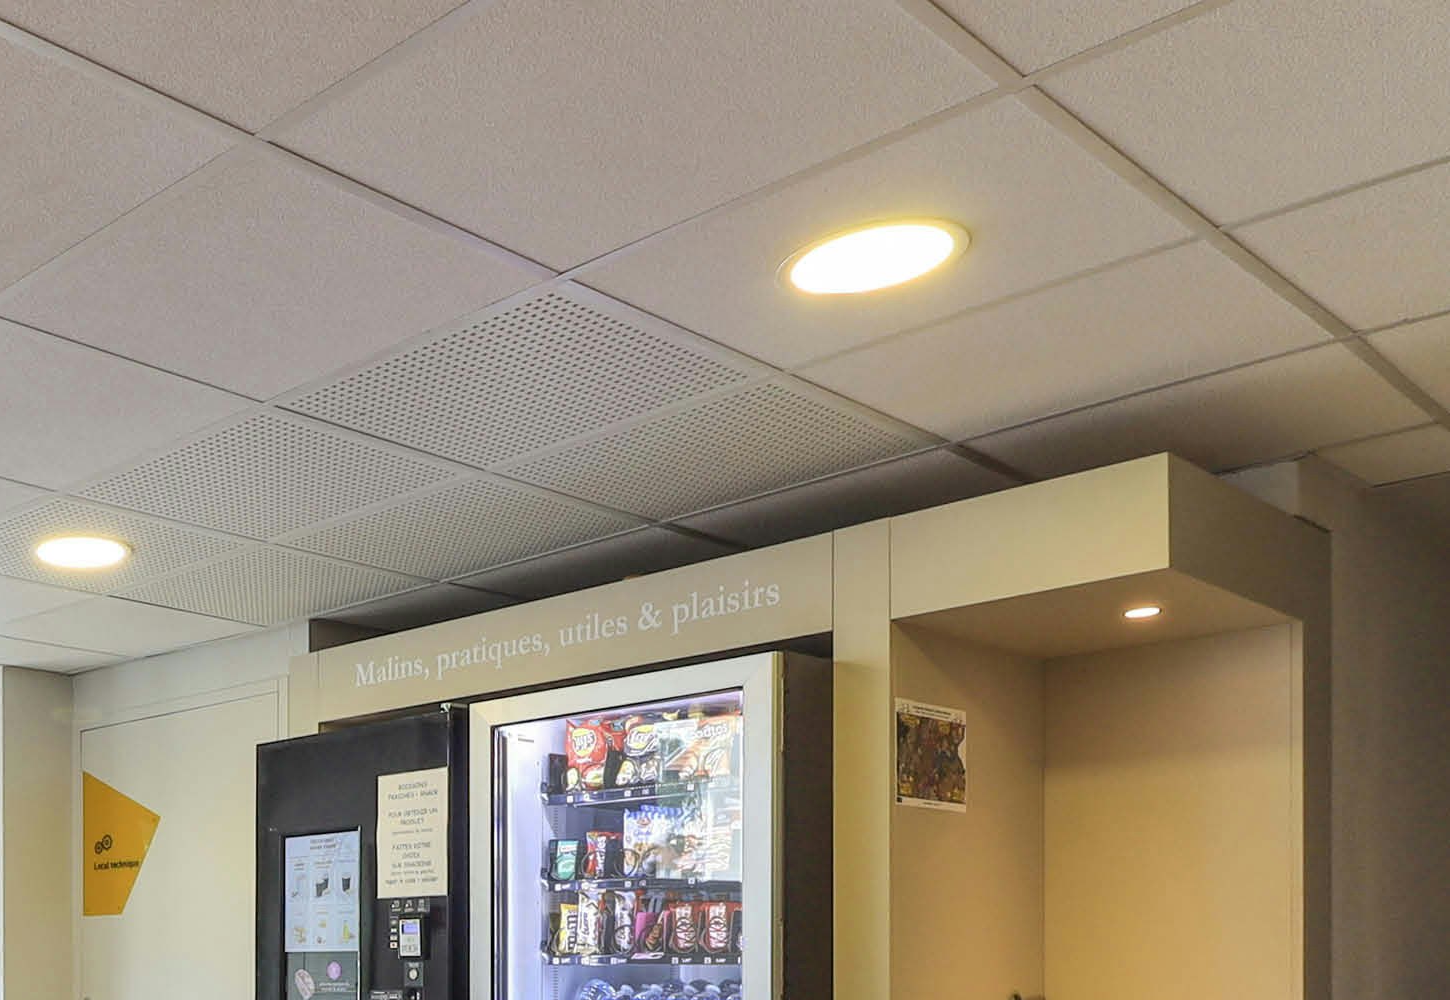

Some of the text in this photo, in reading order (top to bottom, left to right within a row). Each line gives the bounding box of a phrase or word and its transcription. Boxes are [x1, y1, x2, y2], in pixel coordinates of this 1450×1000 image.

[354, 579, 781, 688] Malins, pratiques, utiles & plaisirs
